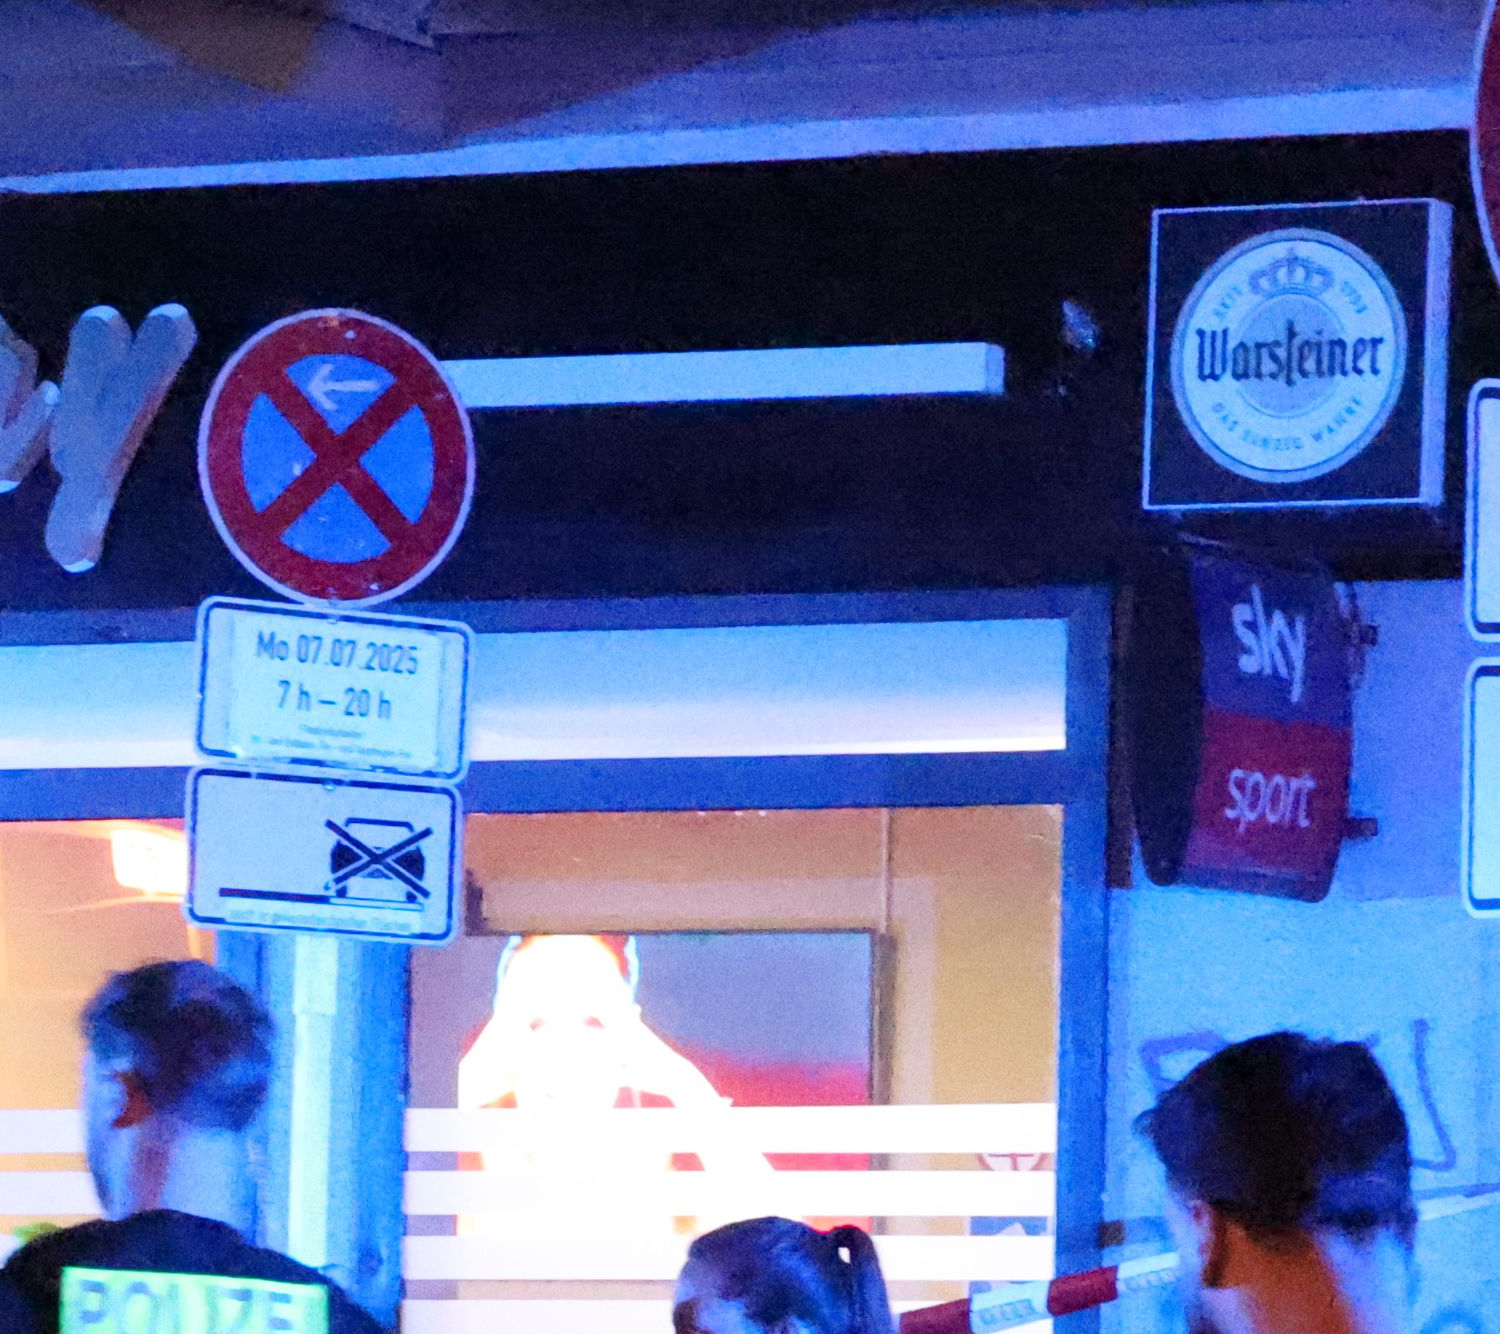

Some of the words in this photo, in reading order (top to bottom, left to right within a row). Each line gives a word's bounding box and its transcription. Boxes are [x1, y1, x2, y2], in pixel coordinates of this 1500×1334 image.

[1196, 318, 1384, 387] Warsteiner
[257, 630, 290, 662] Mo
[296, 633, 419, 675] 07.07.2025
[1232, 583, 1306, 704] sky
[278, 679, 291, 708] 7
[297, 682, 311, 712] h
[343, 686, 370, 718] 20
[378, 689, 392, 720] h
[1224, 767, 1317, 834] sport
